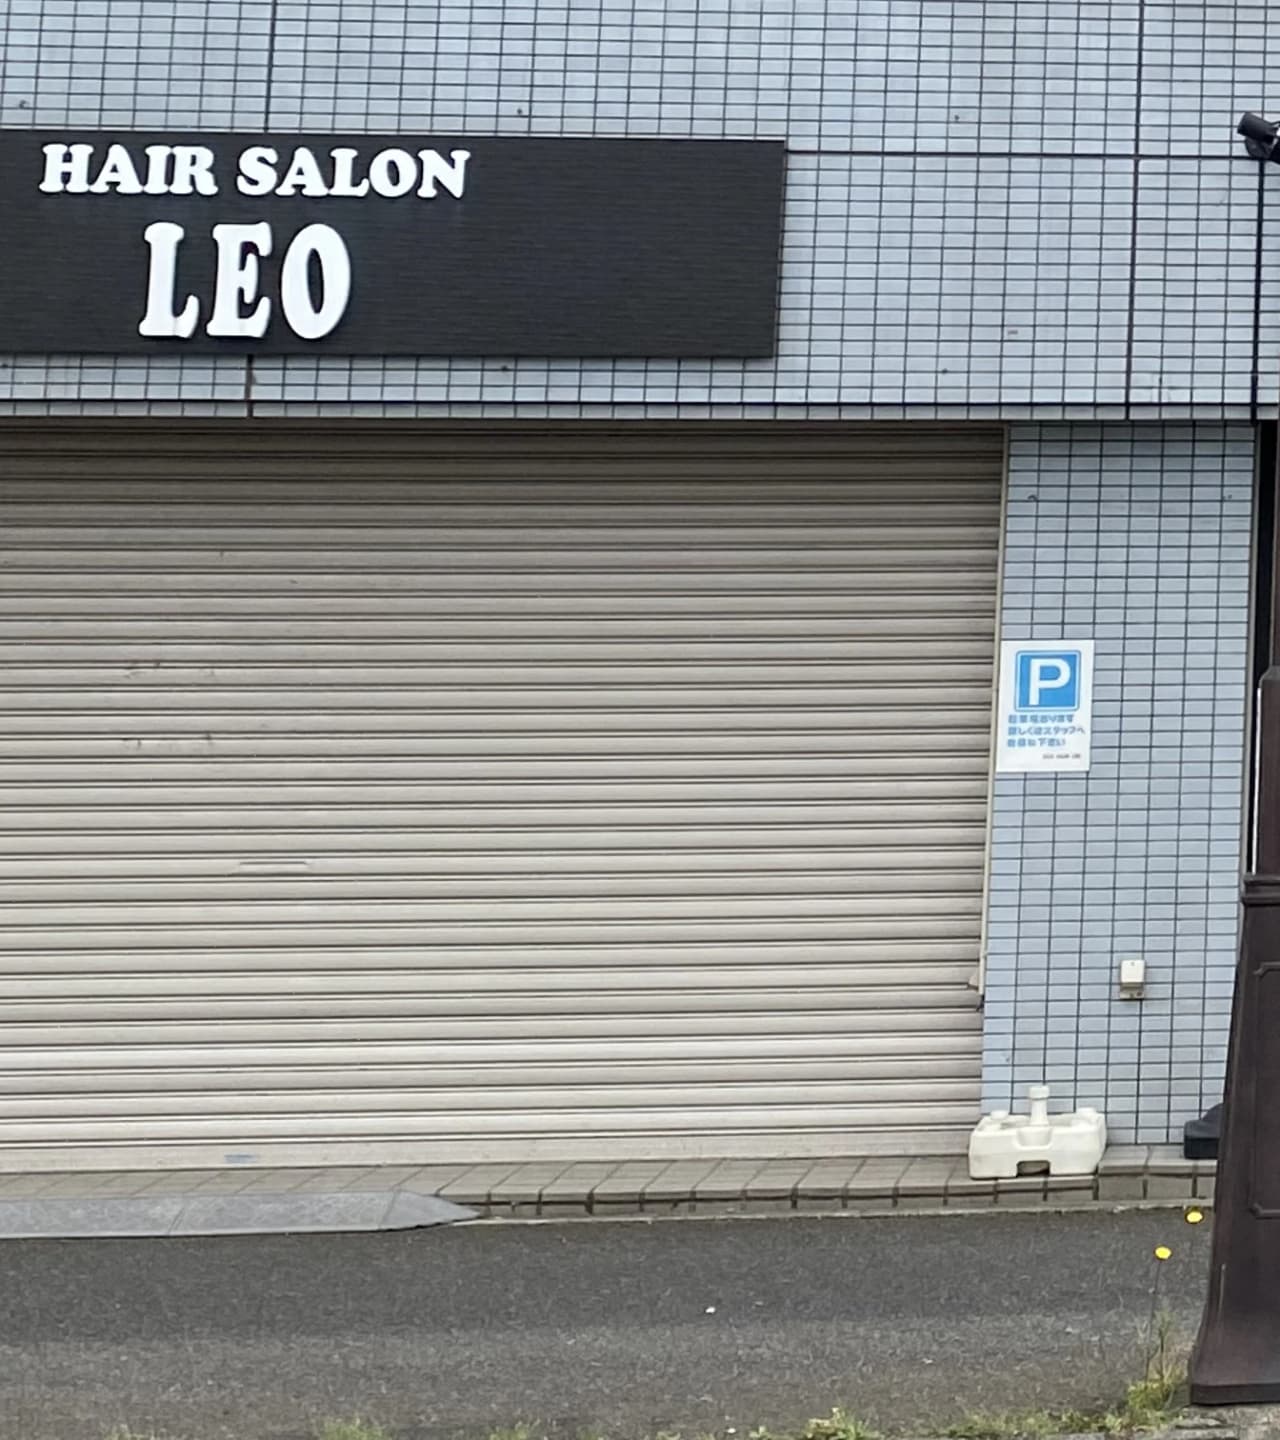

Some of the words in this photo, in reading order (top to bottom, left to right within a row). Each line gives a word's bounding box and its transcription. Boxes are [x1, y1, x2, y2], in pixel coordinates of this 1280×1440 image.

[38, 143, 219, 197] HAIR
[236, 146, 471, 199] SALON
[138, 221, 352, 340] LEO
[1028, 657, 1072, 706] P
